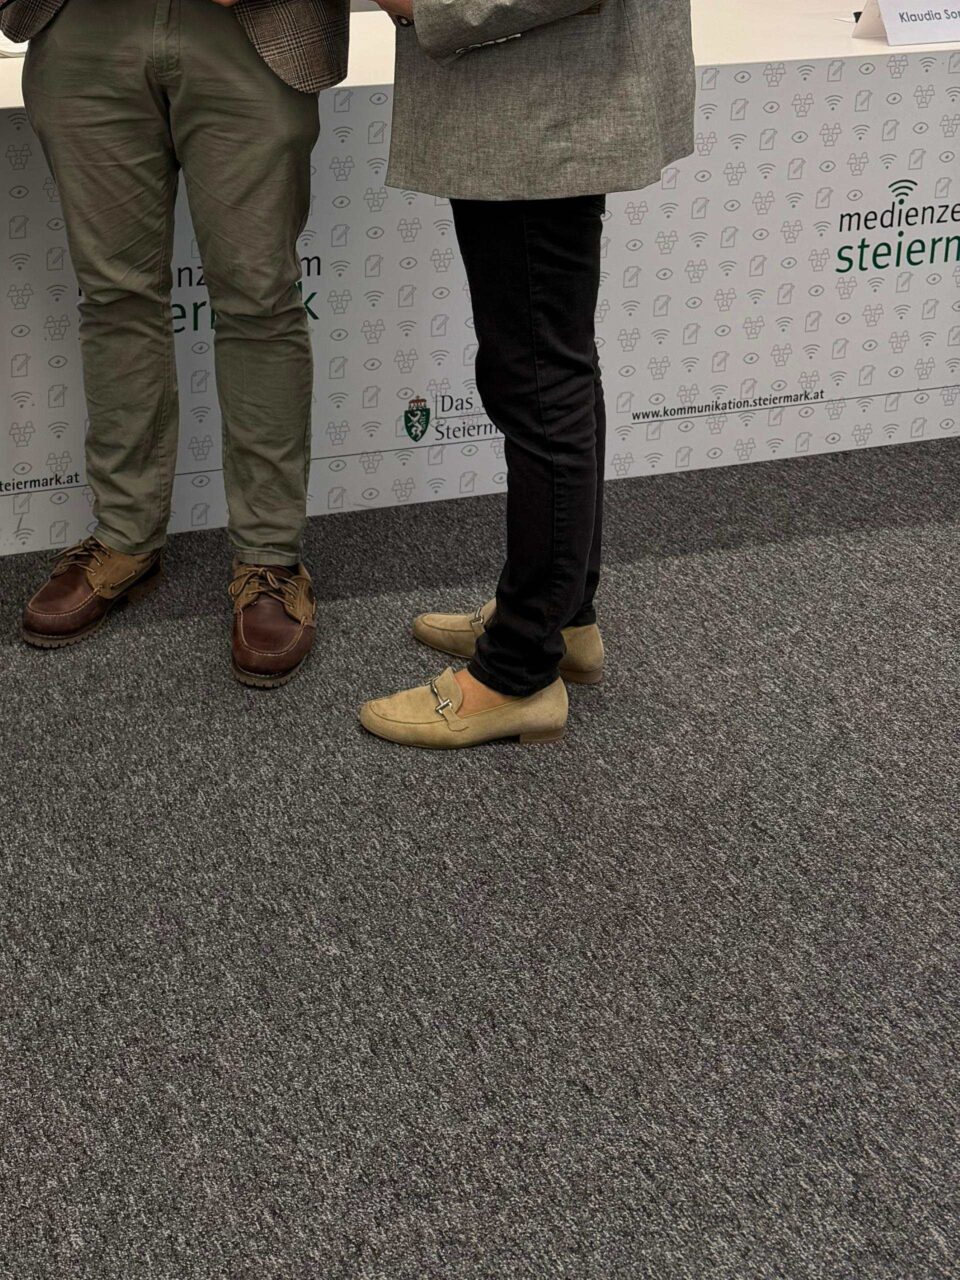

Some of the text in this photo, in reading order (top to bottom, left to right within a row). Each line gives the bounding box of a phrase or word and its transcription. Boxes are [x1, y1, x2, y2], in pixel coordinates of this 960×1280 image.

[898, 10, 943, 23] Klaudia
[440, 394, 474, 413] Das
[631, 389, 825, 422] www.kommunikation.steiermark.at
